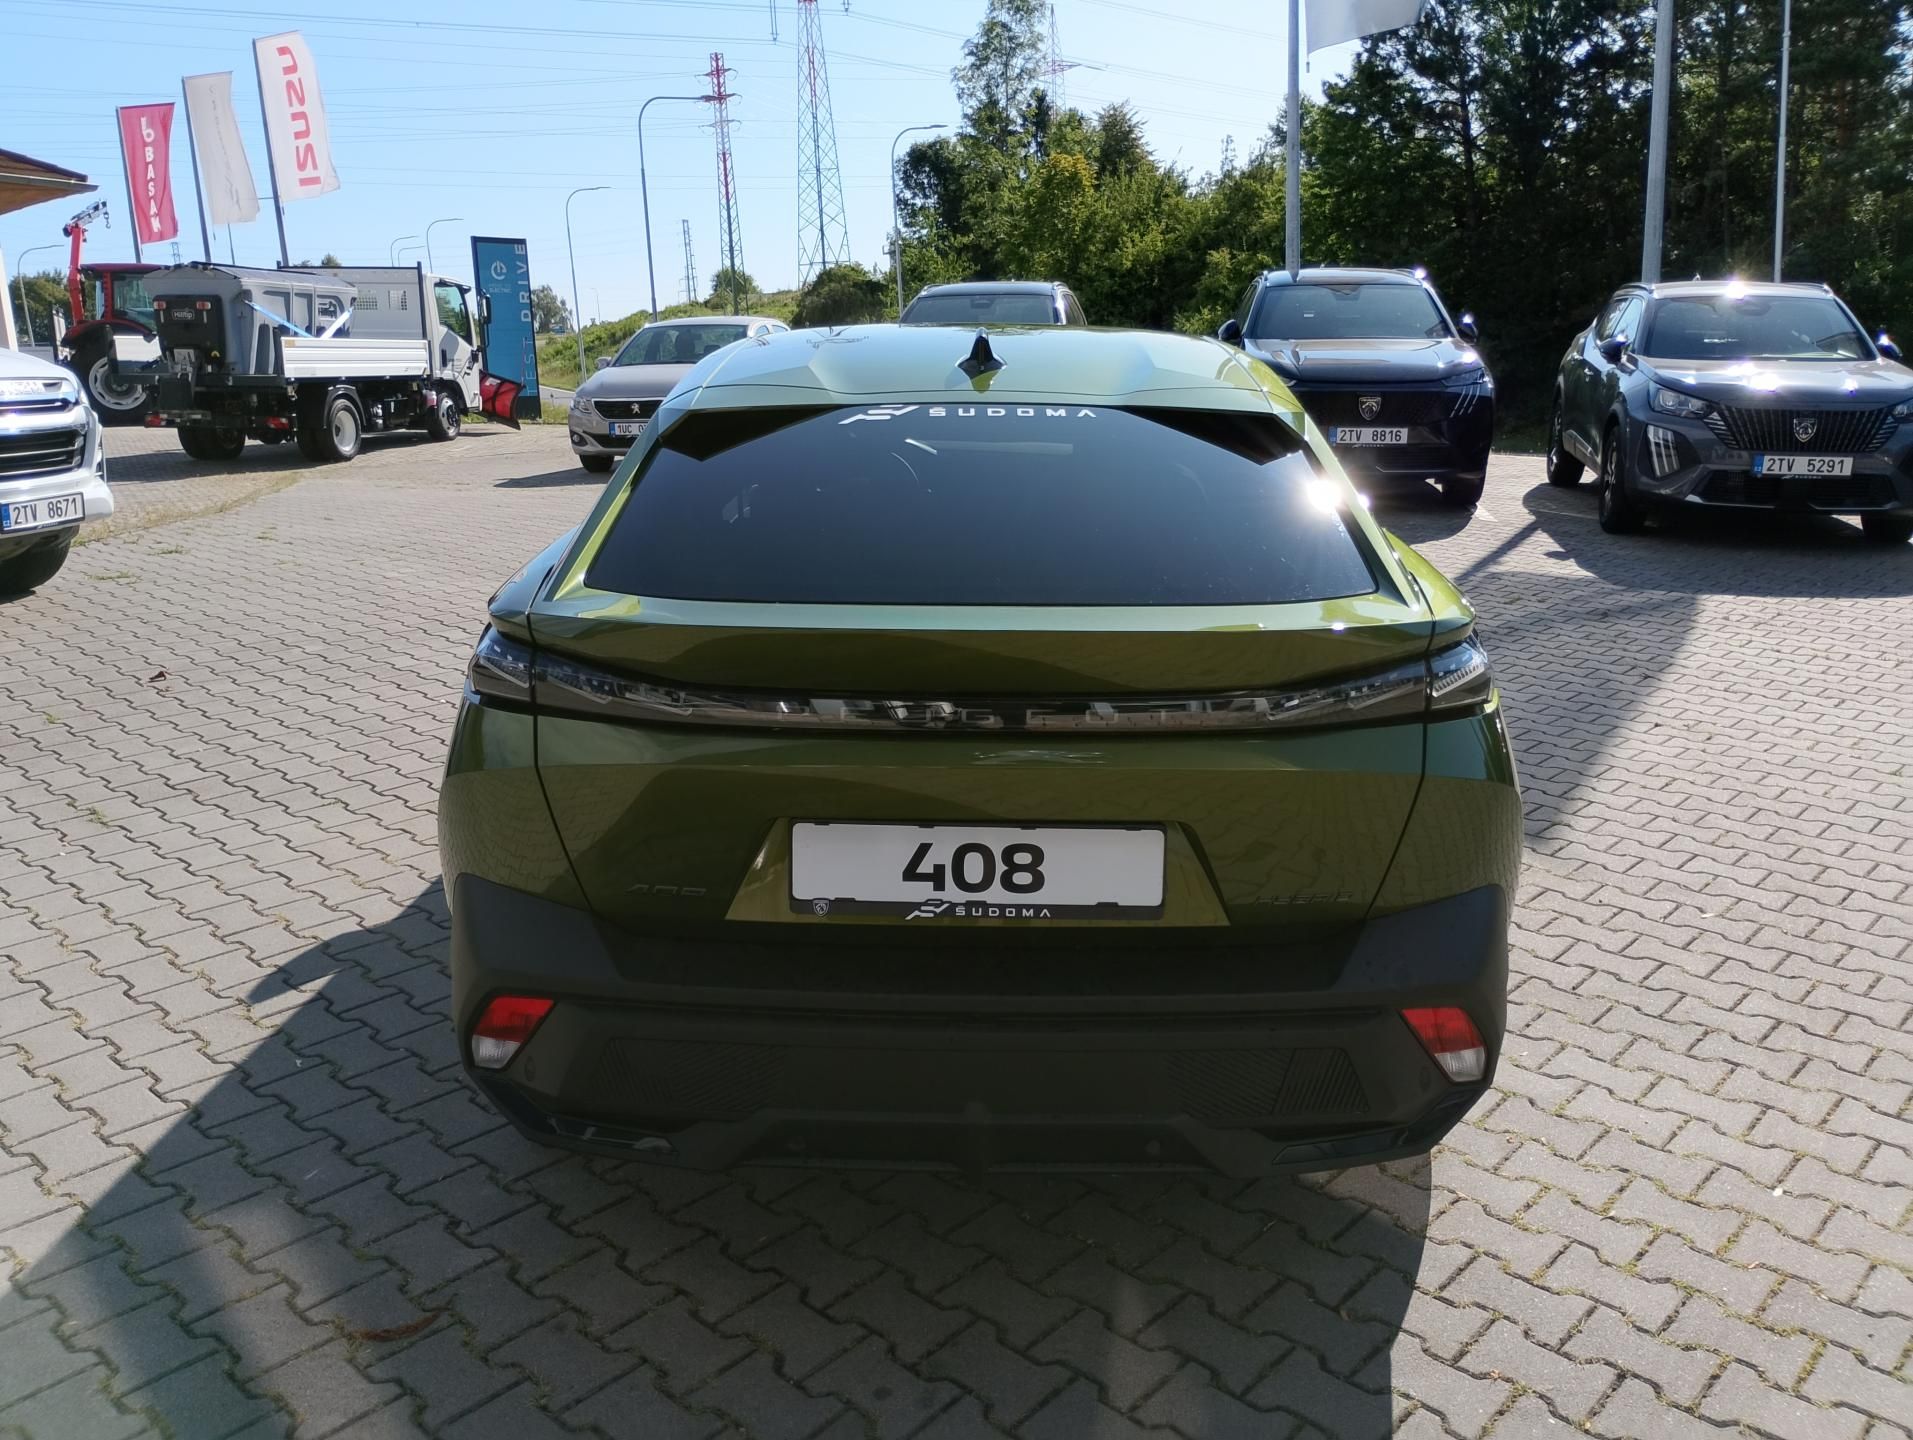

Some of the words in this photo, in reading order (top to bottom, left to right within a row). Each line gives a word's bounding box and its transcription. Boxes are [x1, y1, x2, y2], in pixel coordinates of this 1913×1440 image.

[276, 46, 322, 187] ISUZU
[514, 243, 533, 323] DRIVE
[522, 337, 538, 396] TEST
[617, 424, 633, 434] 1UC
[1339, 429, 1362, 442] 2TV
[1371, 429, 1402, 442] 8816
[1766, 458, 1796, 473] 2TV
[1807, 458, 1845, 474] 5291
[13, 503, 38, 525] 2TV
[47, 497, 78, 519] 8671
[901, 842, 1046, 895] 408
